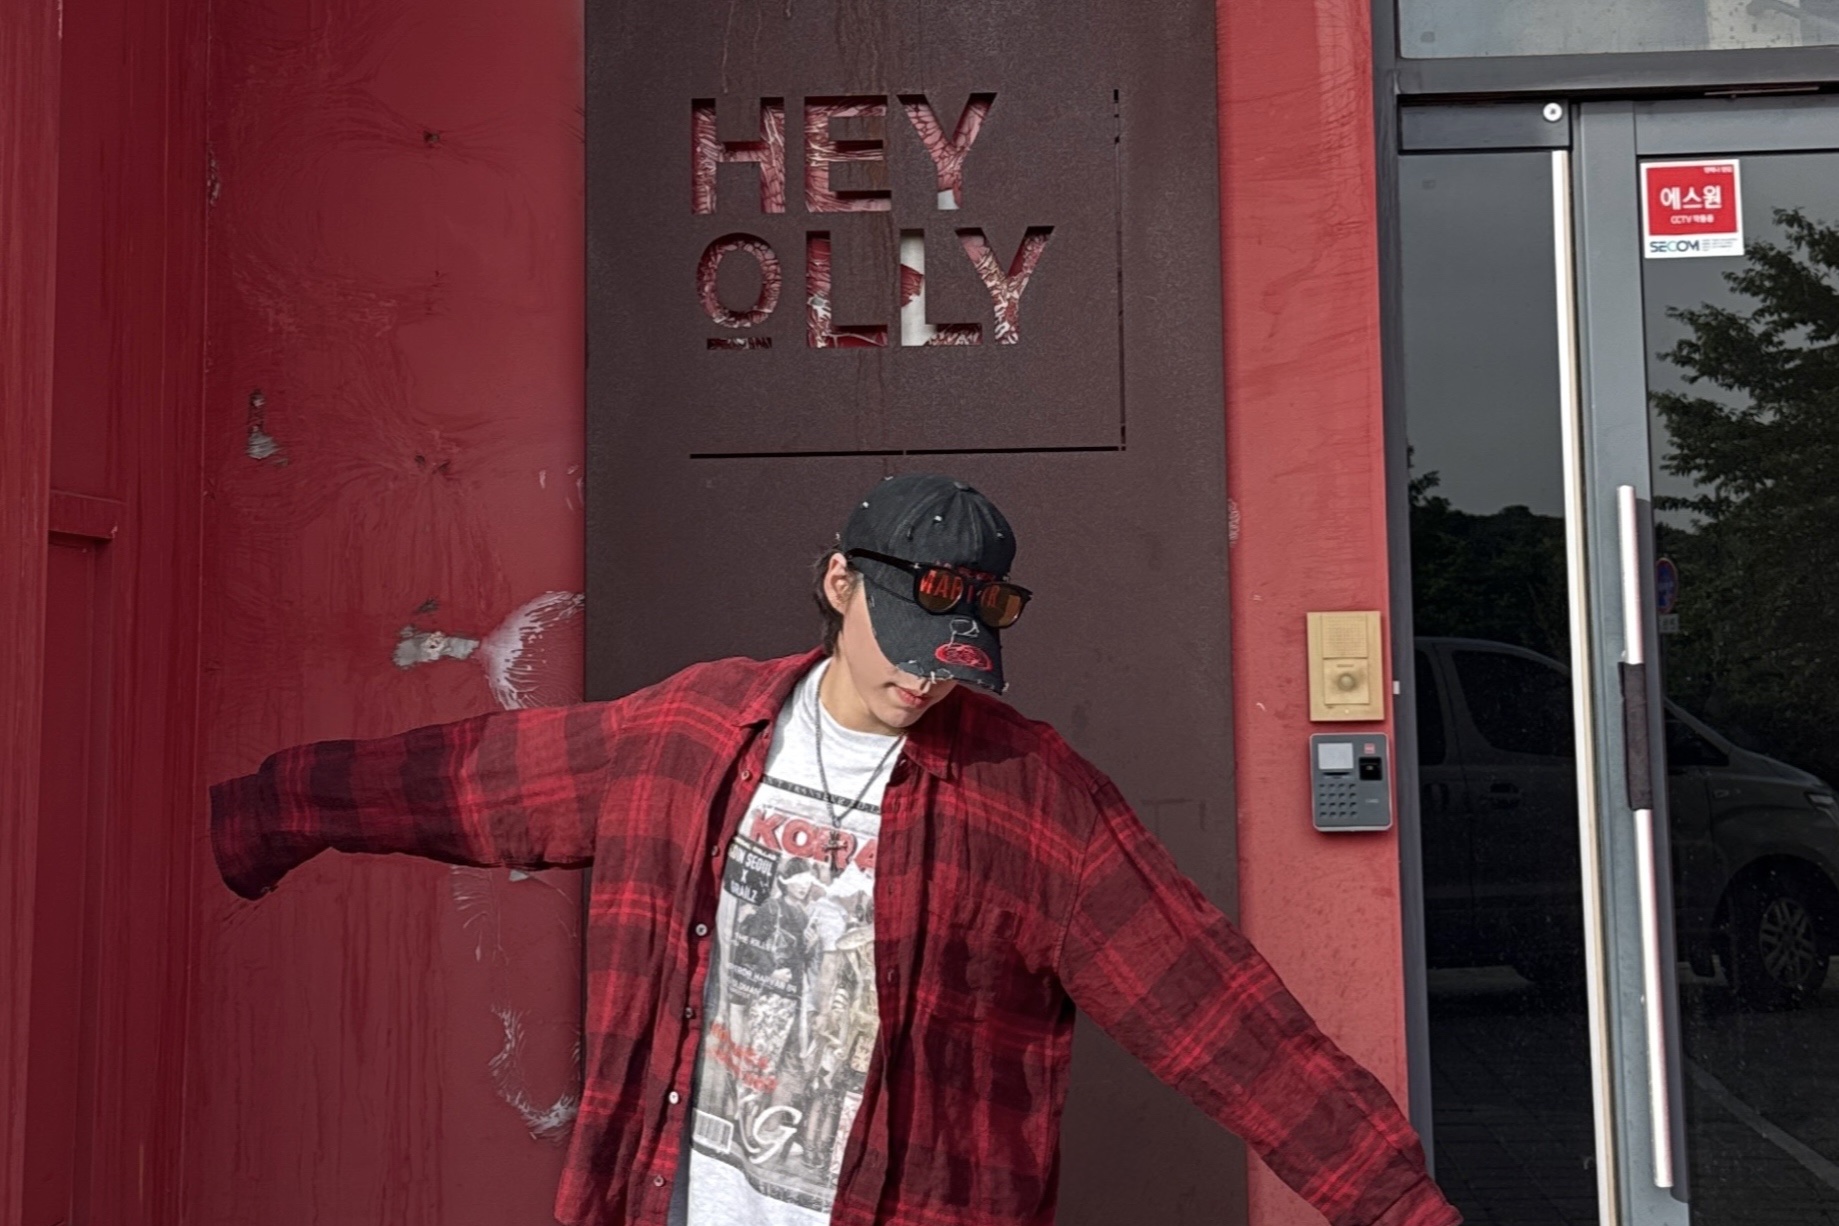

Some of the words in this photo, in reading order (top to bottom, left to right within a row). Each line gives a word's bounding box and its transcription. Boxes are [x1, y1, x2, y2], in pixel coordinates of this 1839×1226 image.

[691, 92, 997, 214] HEY
[1660, 185, 1722, 210] 에스원
[1670, 214, 1691, 225] CCTV
[1649, 239, 1700, 253] SECOM
[697, 226, 1055, 349] OLLY
